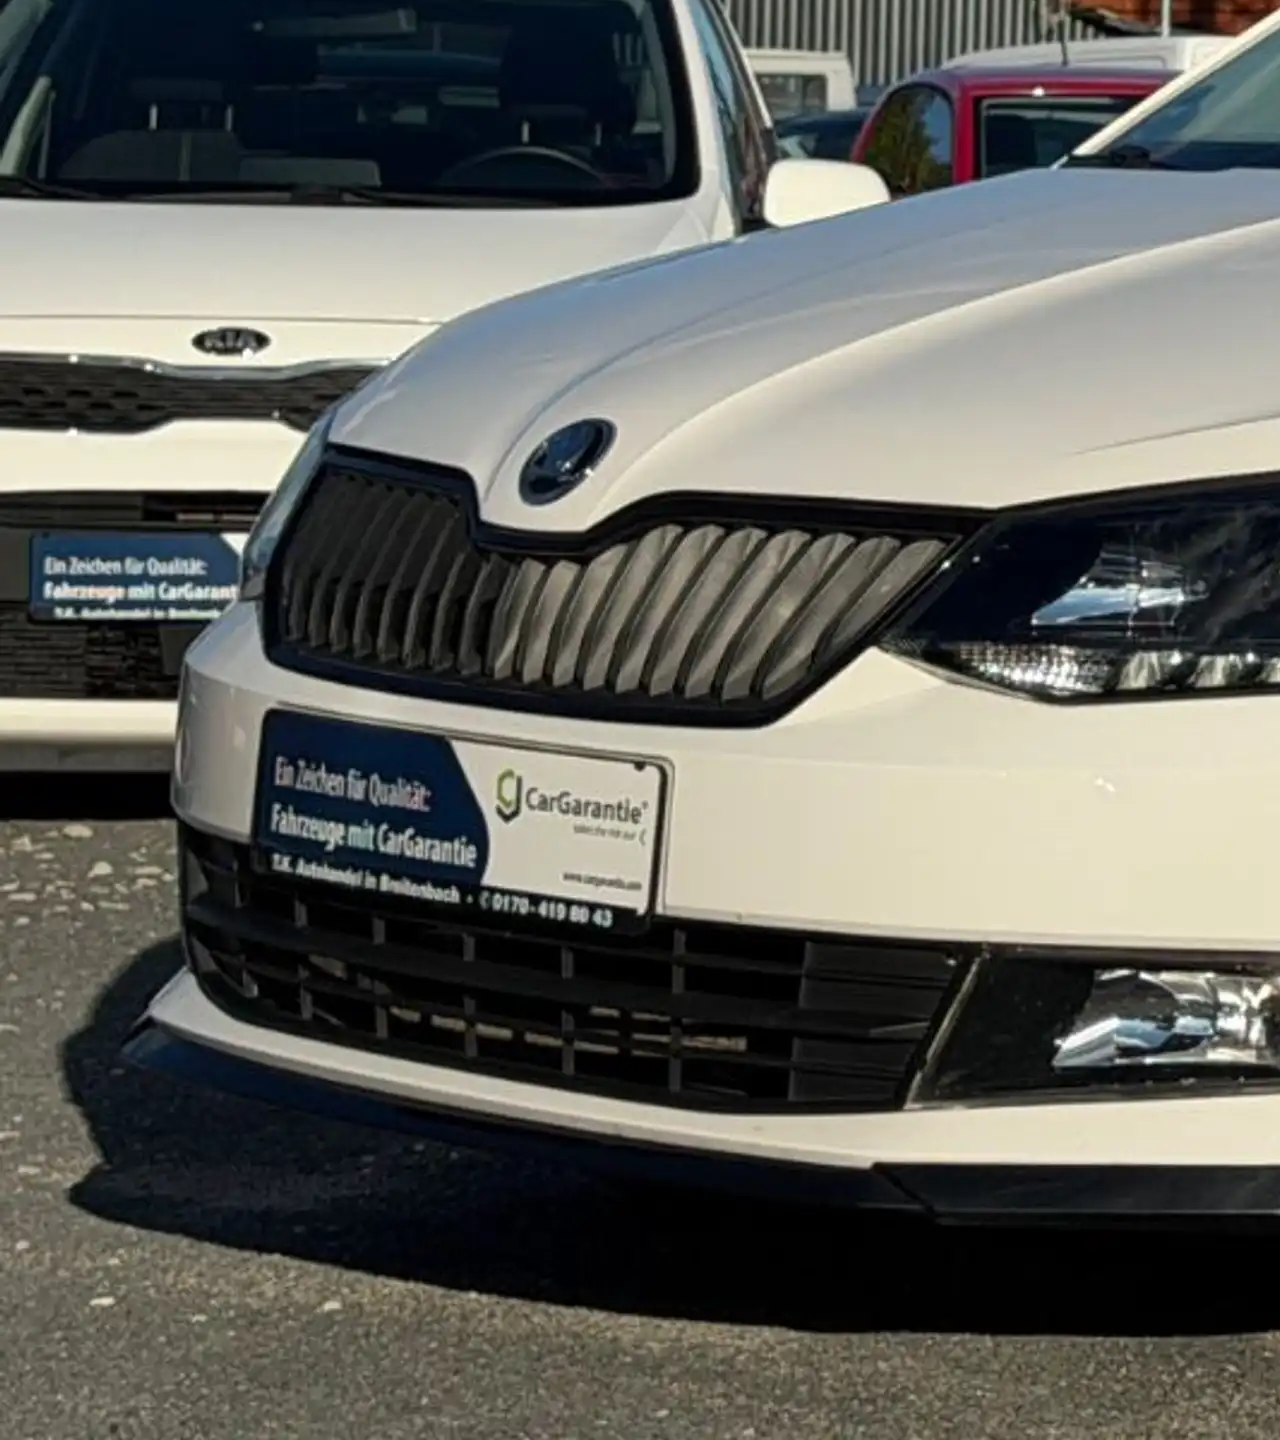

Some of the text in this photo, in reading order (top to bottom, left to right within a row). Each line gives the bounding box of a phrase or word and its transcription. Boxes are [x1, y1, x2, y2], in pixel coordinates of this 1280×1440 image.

[44, 557, 66, 575] Ein
[68, 557, 121, 576] Zeichen
[43, 581, 125, 604] Fahrzeuge
[127, 581, 155, 600] mit
[275, 756, 432, 812] Ein Zeichen für Qualität:
[270, 802, 478, 868] Fahrzeuge mit CarGarantie
